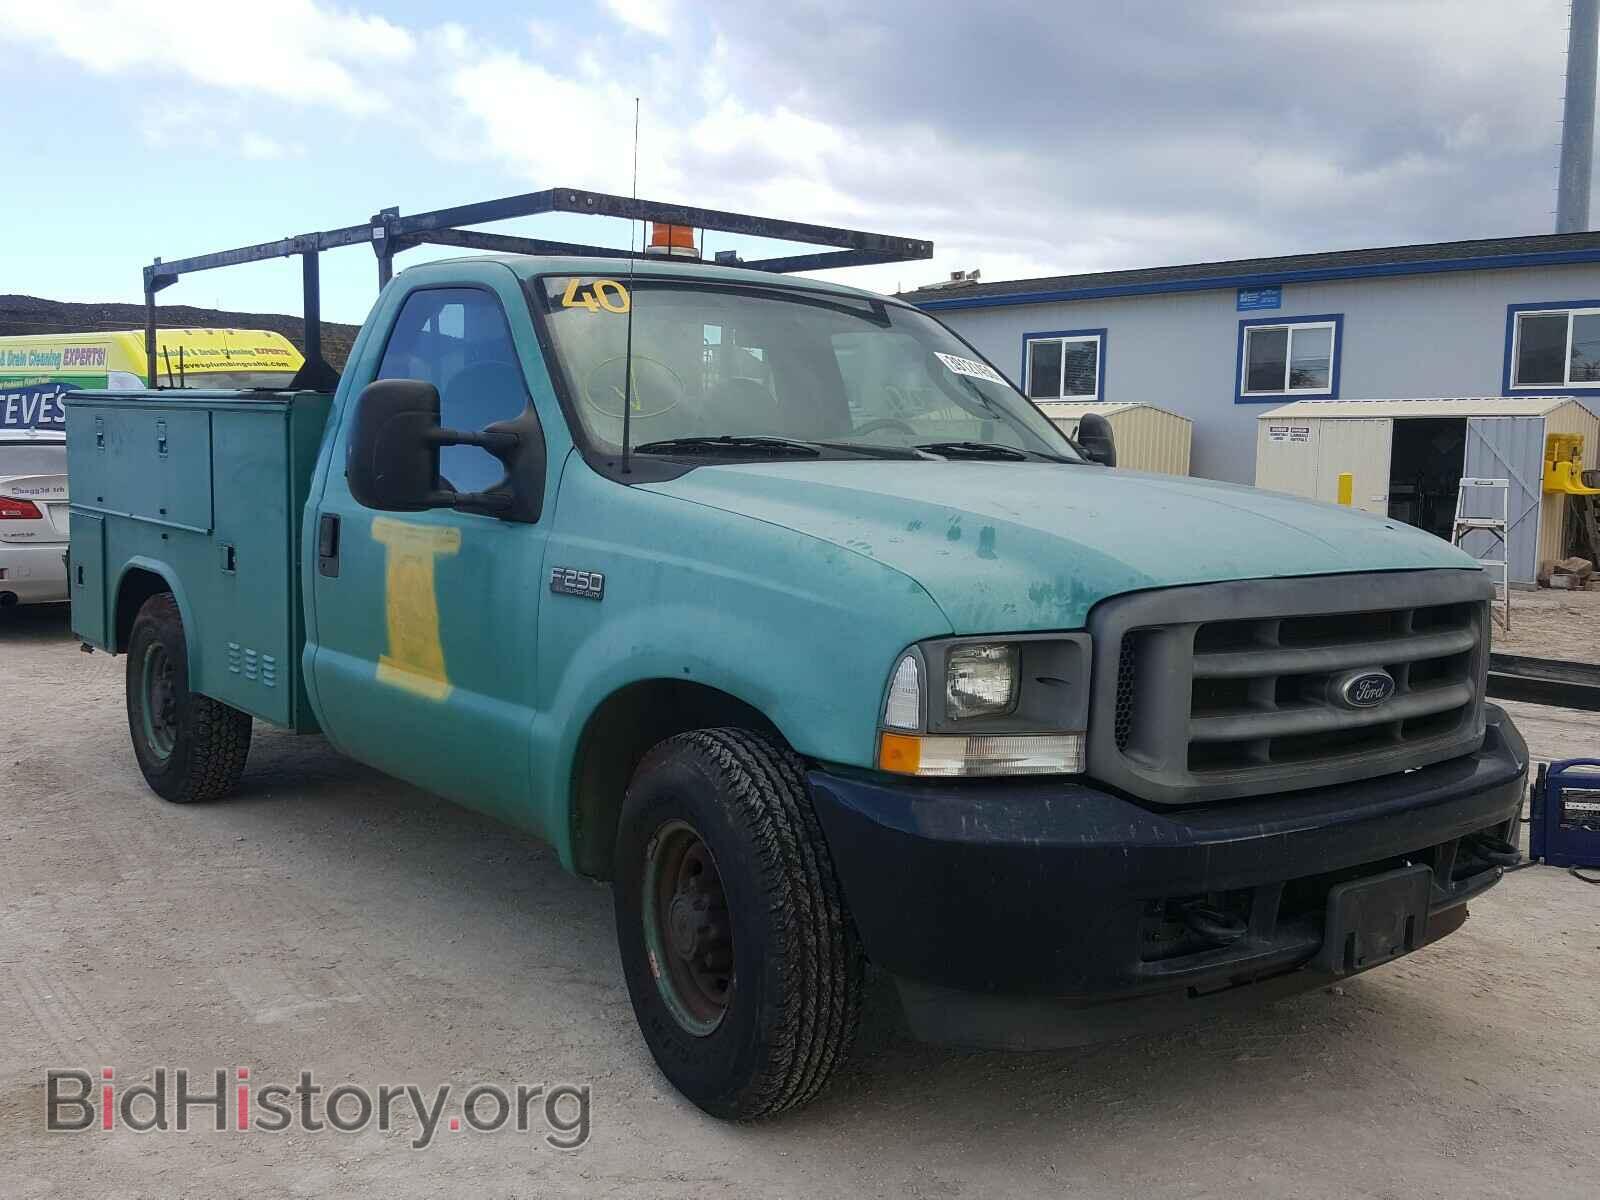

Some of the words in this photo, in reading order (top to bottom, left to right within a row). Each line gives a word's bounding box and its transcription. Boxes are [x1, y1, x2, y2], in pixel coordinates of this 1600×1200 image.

[561, 278, 630, 313] 40
[28, 349, 62, 369] Cleaning
[63, 348, 106, 366] EXPERTS!
[175, 360, 290, 370] sevesplumbingoahu.com
[1356, 680, 1385, 701] Ford
